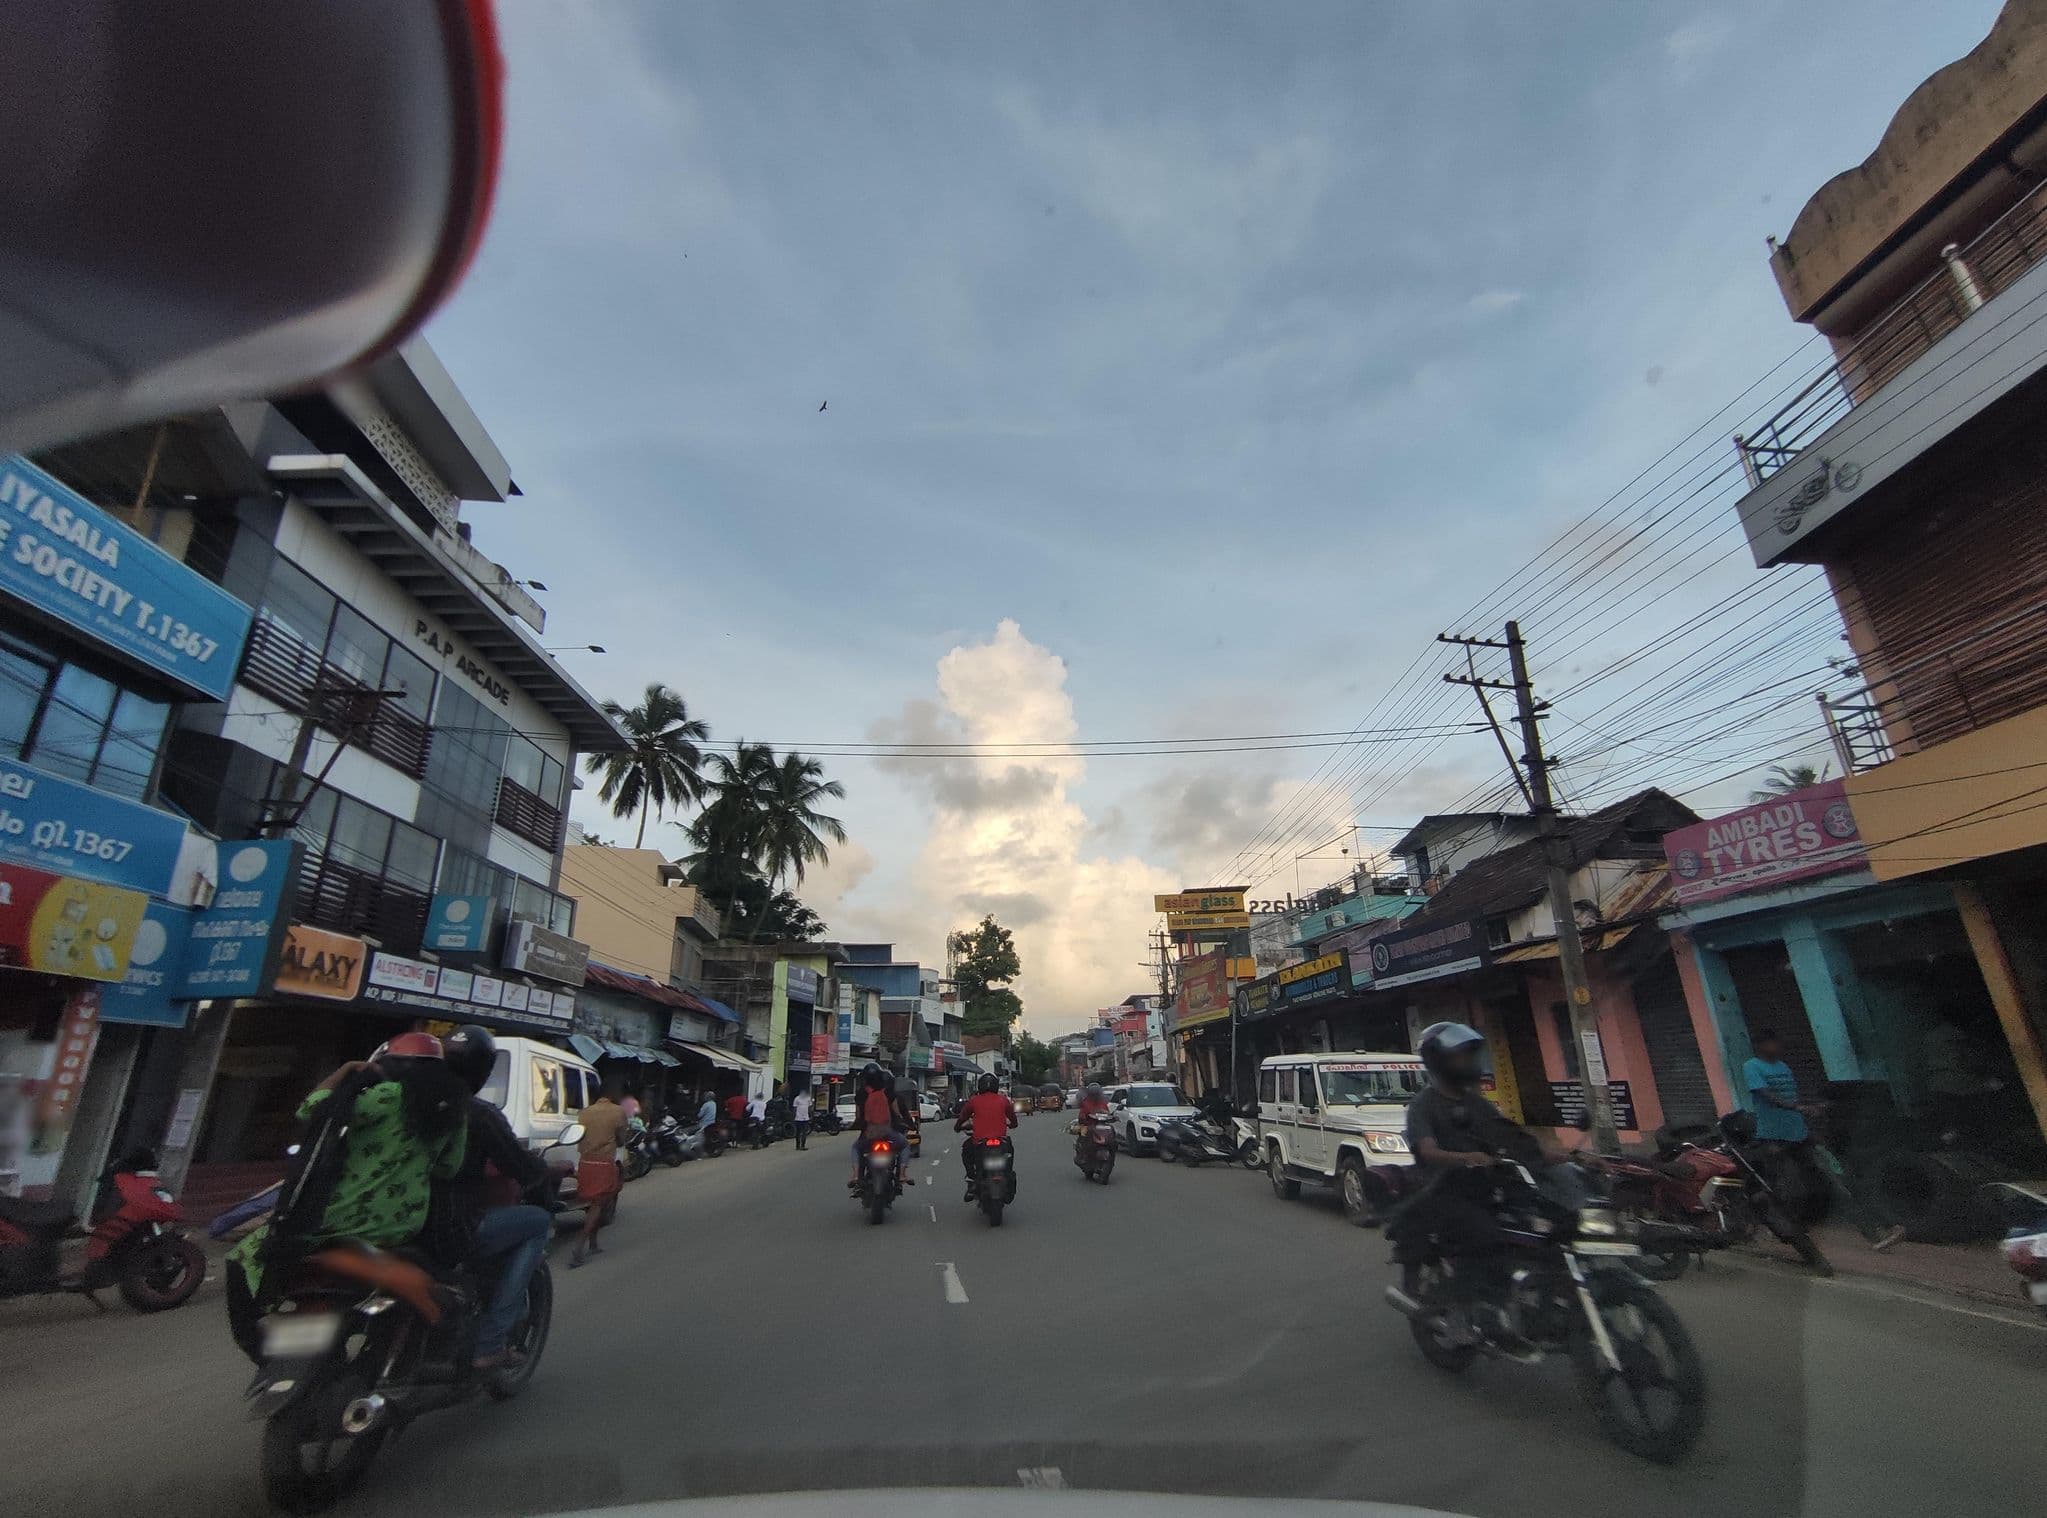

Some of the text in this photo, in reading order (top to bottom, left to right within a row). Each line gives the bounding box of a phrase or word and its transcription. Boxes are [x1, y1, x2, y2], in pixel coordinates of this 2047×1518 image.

[13, 533, 133, 617] SOCIETY
[136, 601, 219, 663] T.1367
[455, 655, 511, 706] ARCADE
[1703, 821, 1822, 875] TYRES
[1707, 802, 1805, 849] AMBADI
[1382, 1063, 1421, 1071] POLICE
